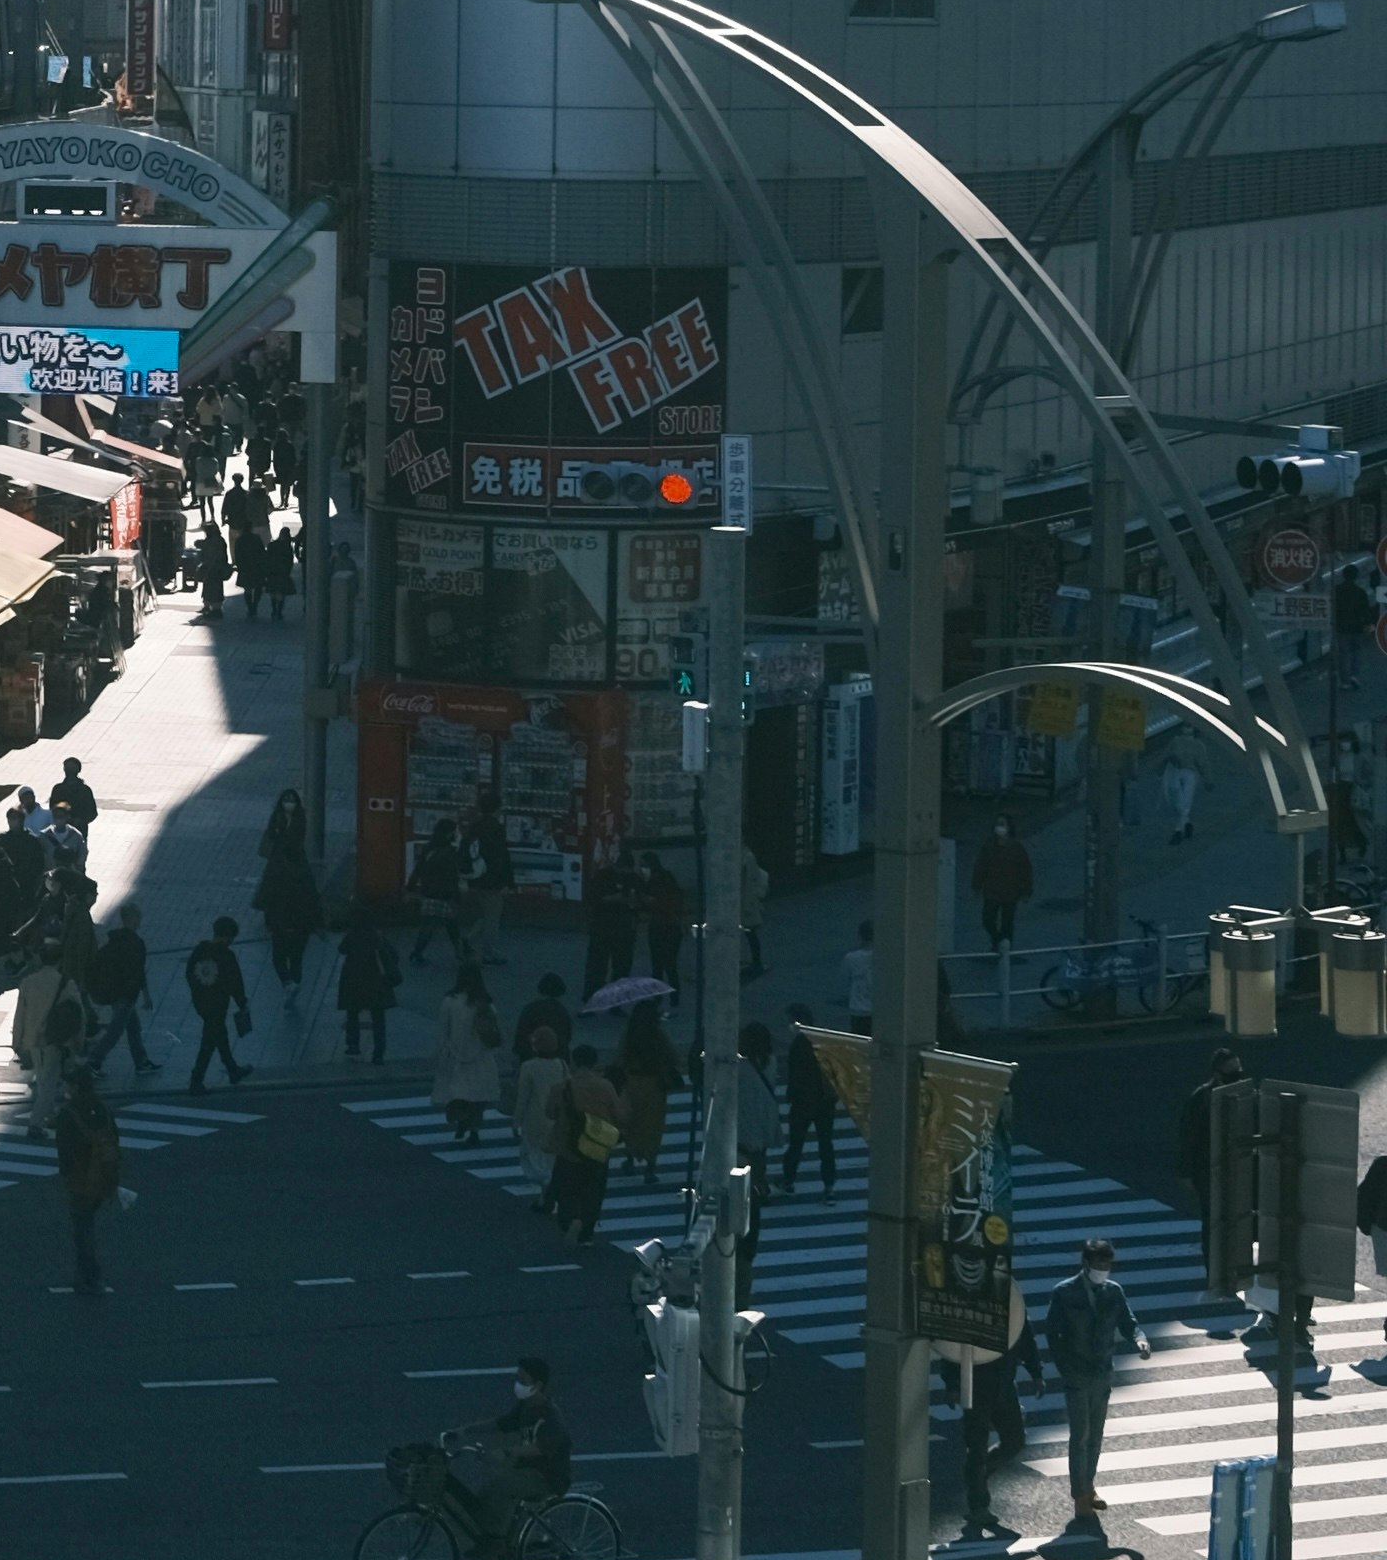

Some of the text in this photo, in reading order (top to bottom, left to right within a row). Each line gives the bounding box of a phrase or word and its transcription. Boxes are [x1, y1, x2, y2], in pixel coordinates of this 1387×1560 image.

[454, 266, 624, 399] TAX
[567, 297, 720, 434] FREE
[658, 405, 723, 435] STORE
[386, 430, 423, 477] TAX
[405, 448, 452, 495] FREE
[1269, 547, 1315, 569] 消火栓
[560, 620, 604, 645] VISA
